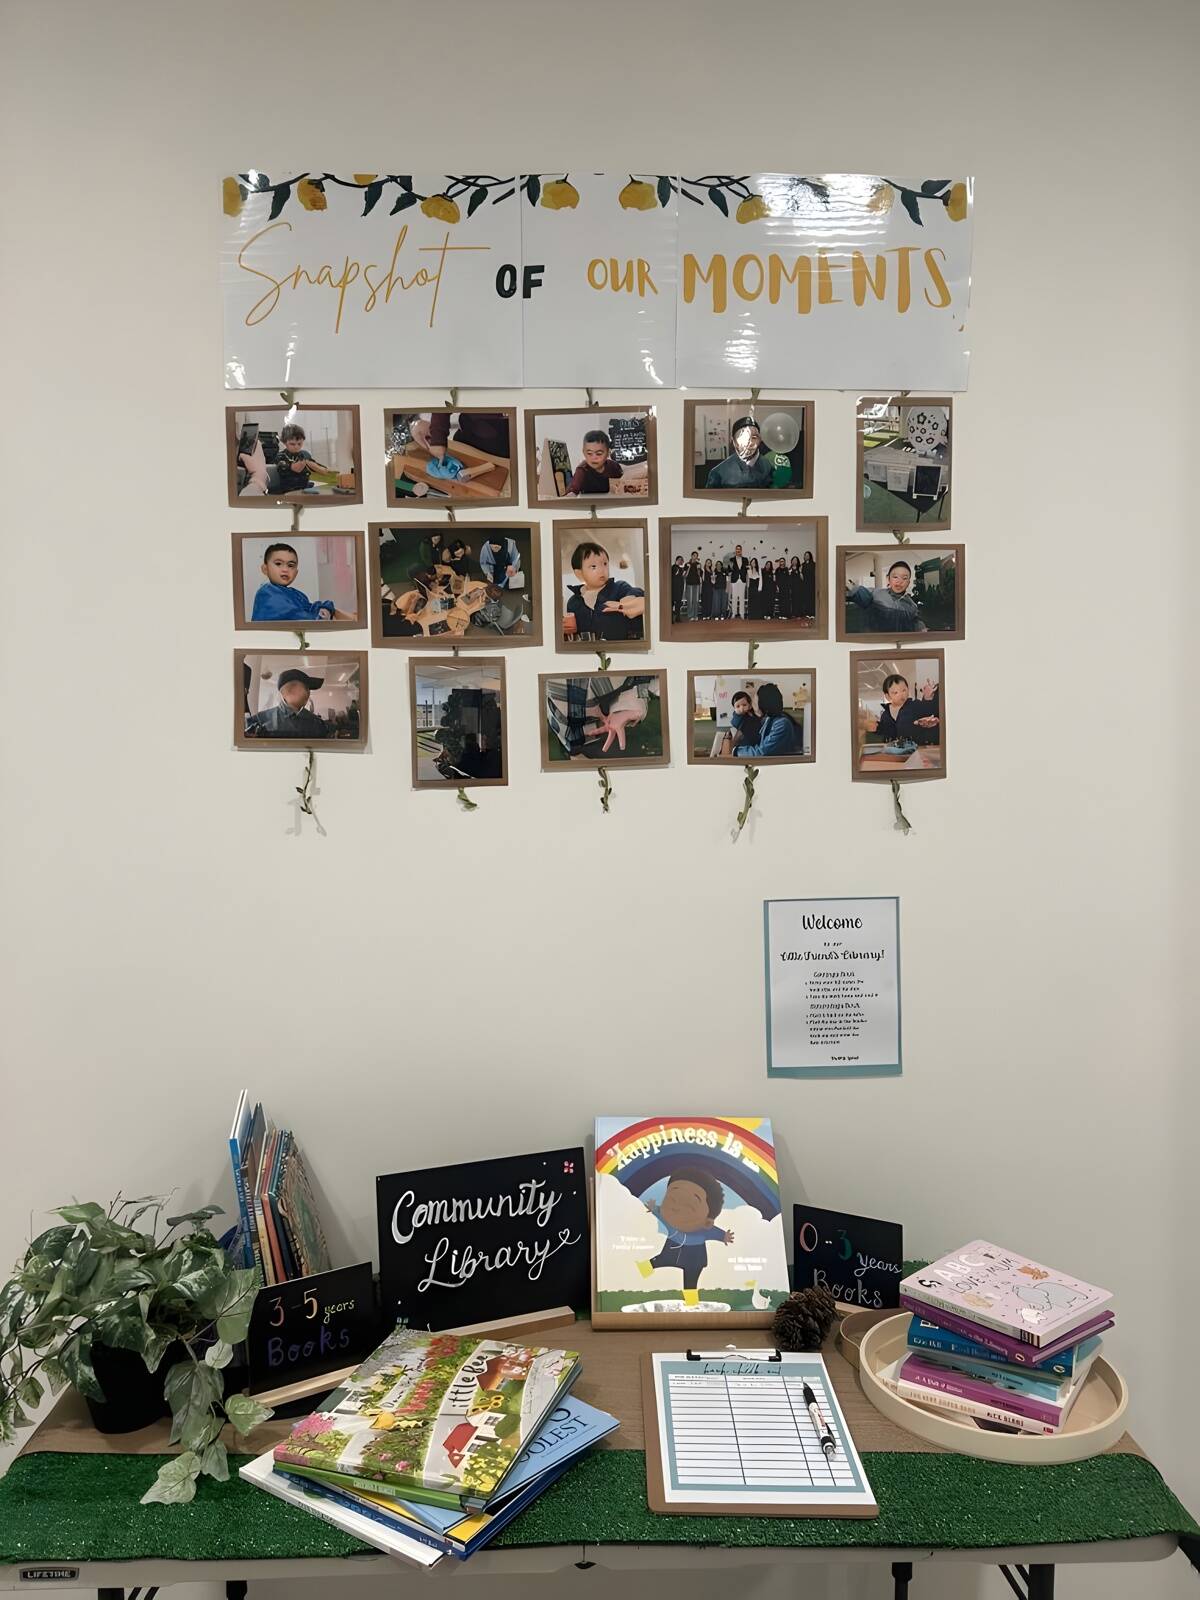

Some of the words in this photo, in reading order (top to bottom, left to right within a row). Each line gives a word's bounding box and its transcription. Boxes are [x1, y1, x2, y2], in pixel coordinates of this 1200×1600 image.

[238, 222, 491, 333] Snapshot
[496, 264, 545, 300] OF
[587, 258, 658, 297] OUR
[683, 247, 952, 314] MOMENTS
[802, 914, 863, 930] Welcome
[606, 1125, 720, 1171] Happiness
[391, 1179, 563, 1244] Community
[417, 1233, 571, 1292] Library
[853, 1250, 902, 1276] years
[813, 1268, 883, 1308] Books
[323, 1299, 355, 1324] years
[267, 1325, 350, 1366] Books
